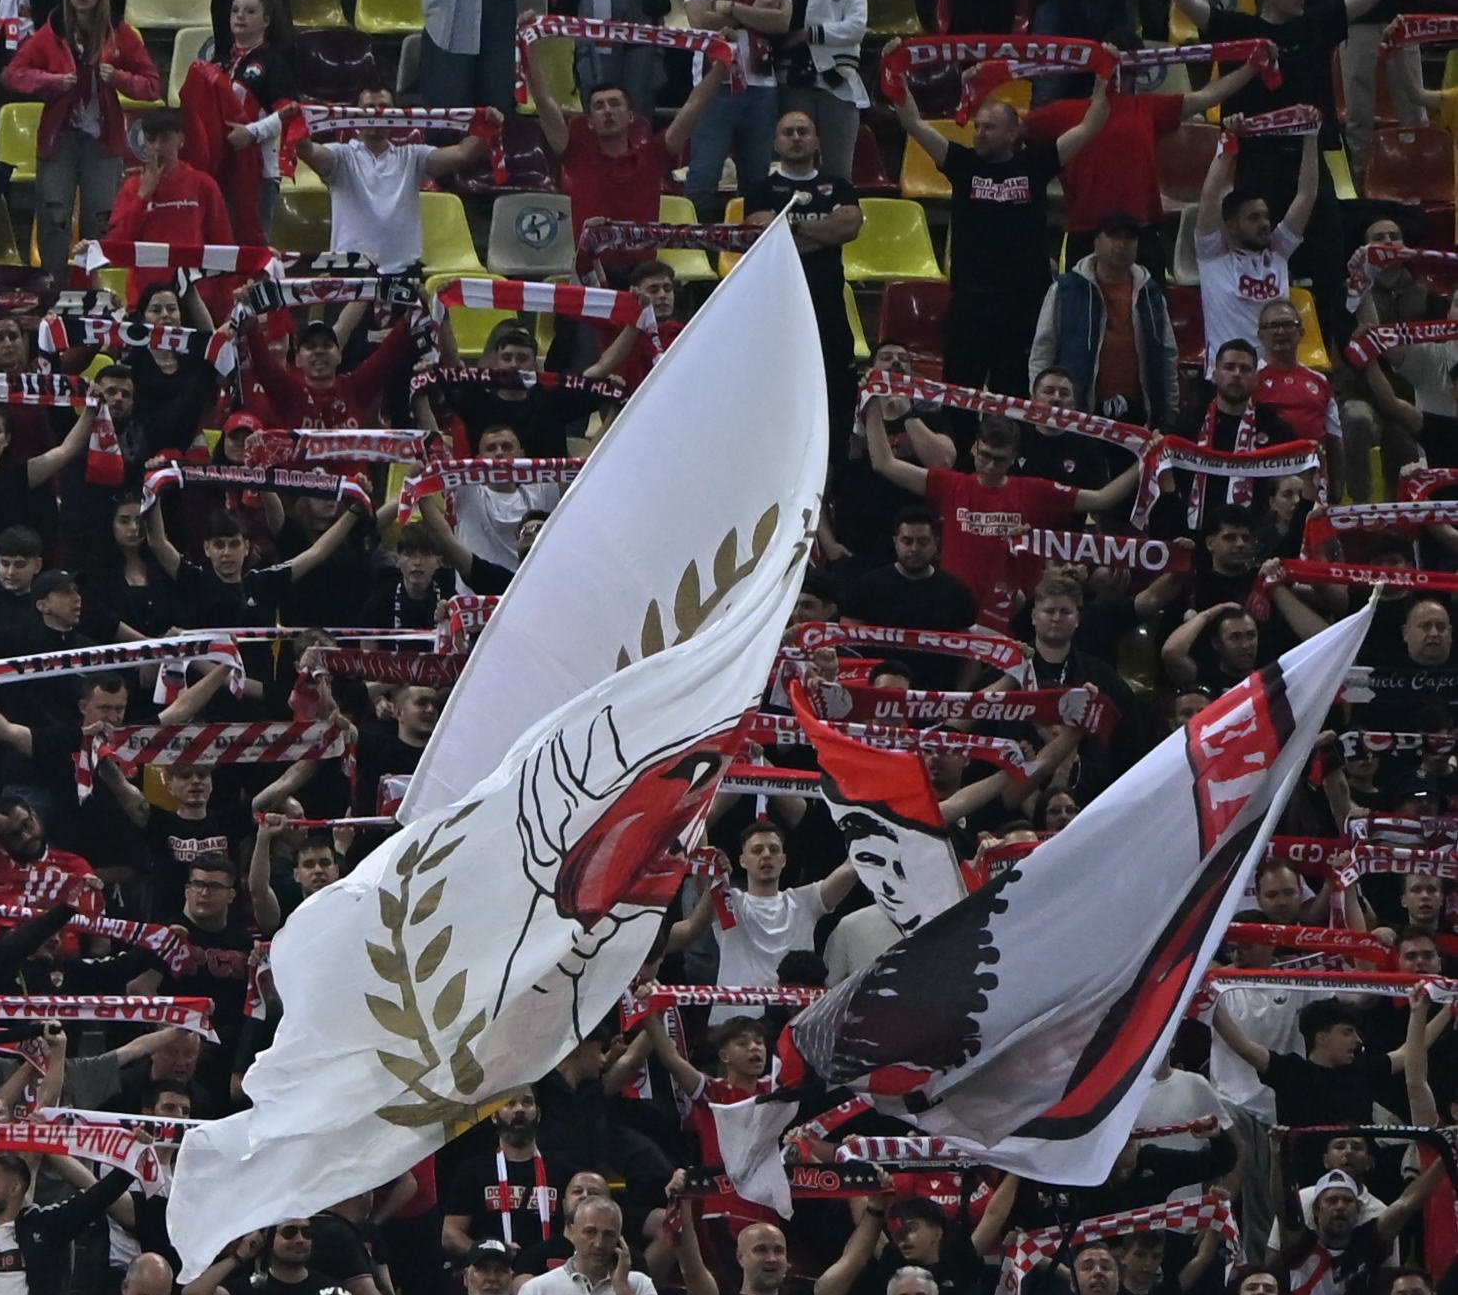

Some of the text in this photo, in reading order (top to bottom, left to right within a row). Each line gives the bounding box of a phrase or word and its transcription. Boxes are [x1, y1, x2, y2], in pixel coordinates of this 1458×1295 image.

[522, 21, 711, 50] BUCURESTI
[908, 41, 1092, 68] DINAMO
[83, 316, 194, 354] PCH
[1330, 566, 1429, 586] DINAMO
[873, 700, 1037, 724] ULTRAS GRUP
